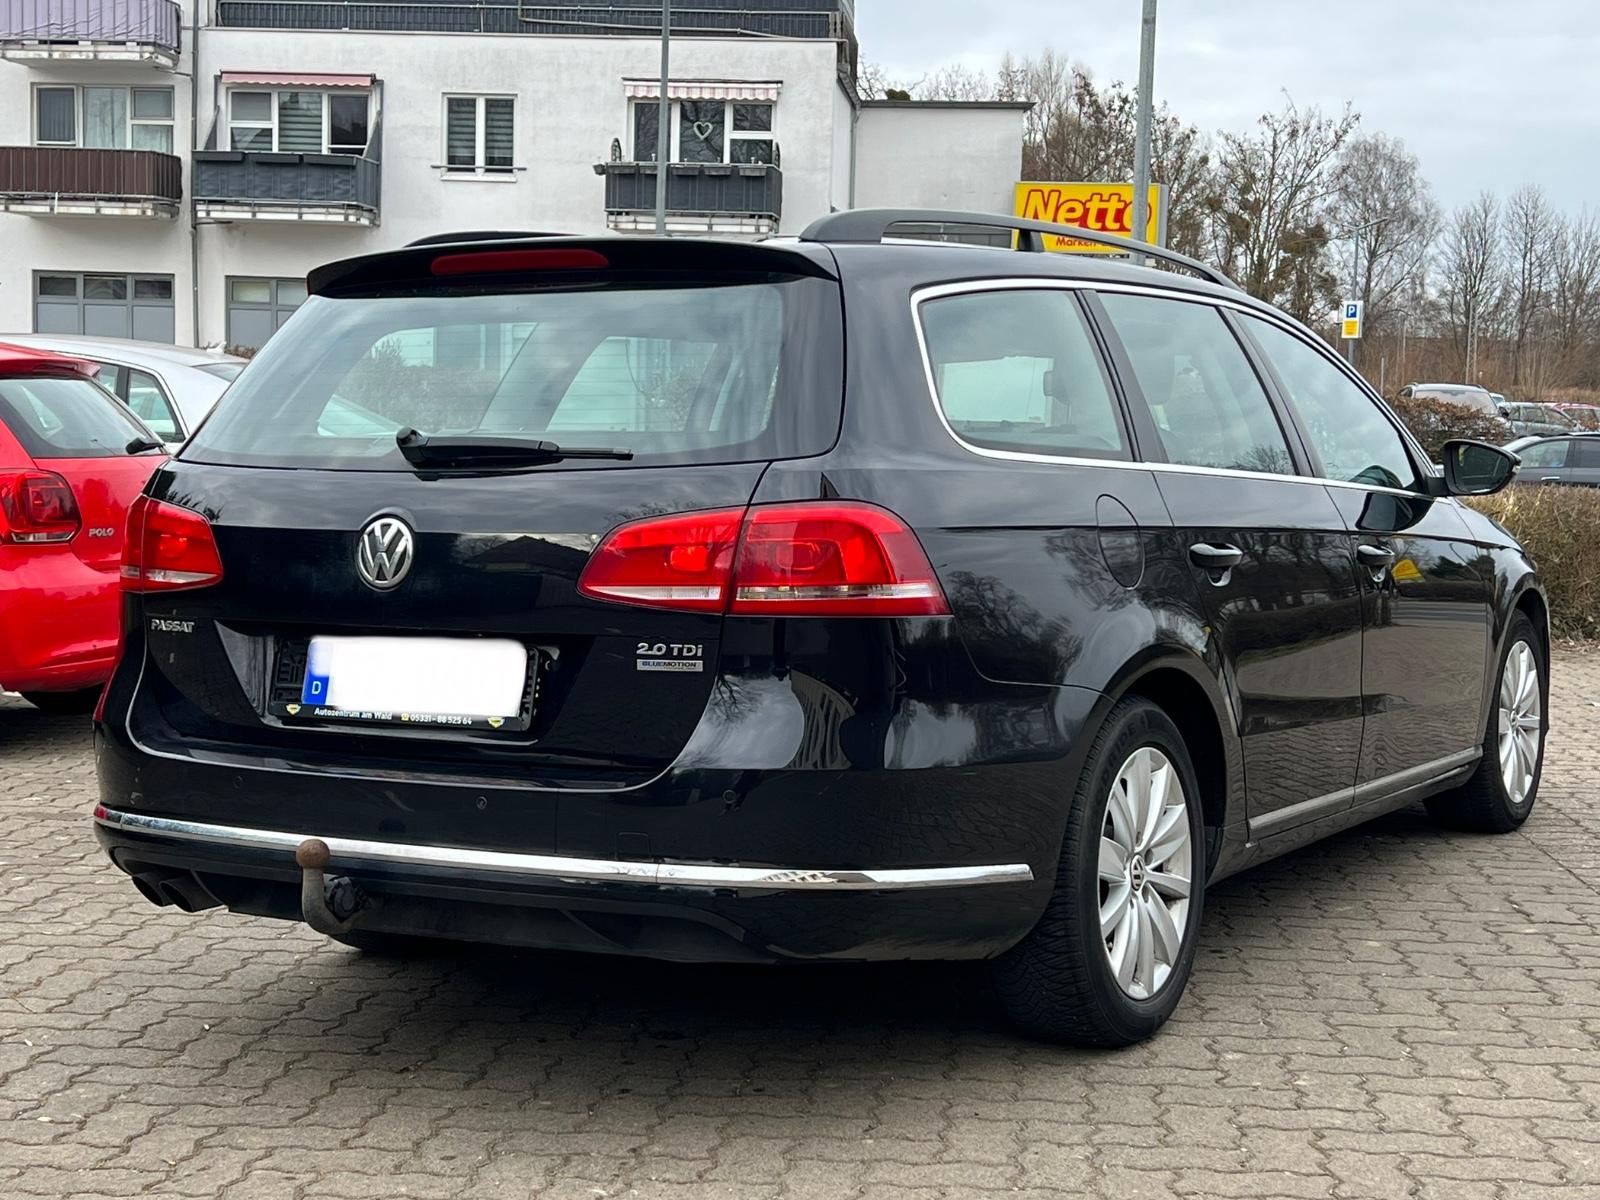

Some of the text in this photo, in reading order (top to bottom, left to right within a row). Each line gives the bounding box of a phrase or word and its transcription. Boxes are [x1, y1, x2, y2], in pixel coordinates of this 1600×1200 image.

[1347, 305, 1356, 317] P
[88, 527, 115, 538] POLO
[359, 517, 413, 588] VW
[151, 619, 195, 633] PASSAT
[636, 642, 667, 655] 2.0
[641, 660, 697, 668] BLUEMOTION
[311, 681, 322, 695] D
